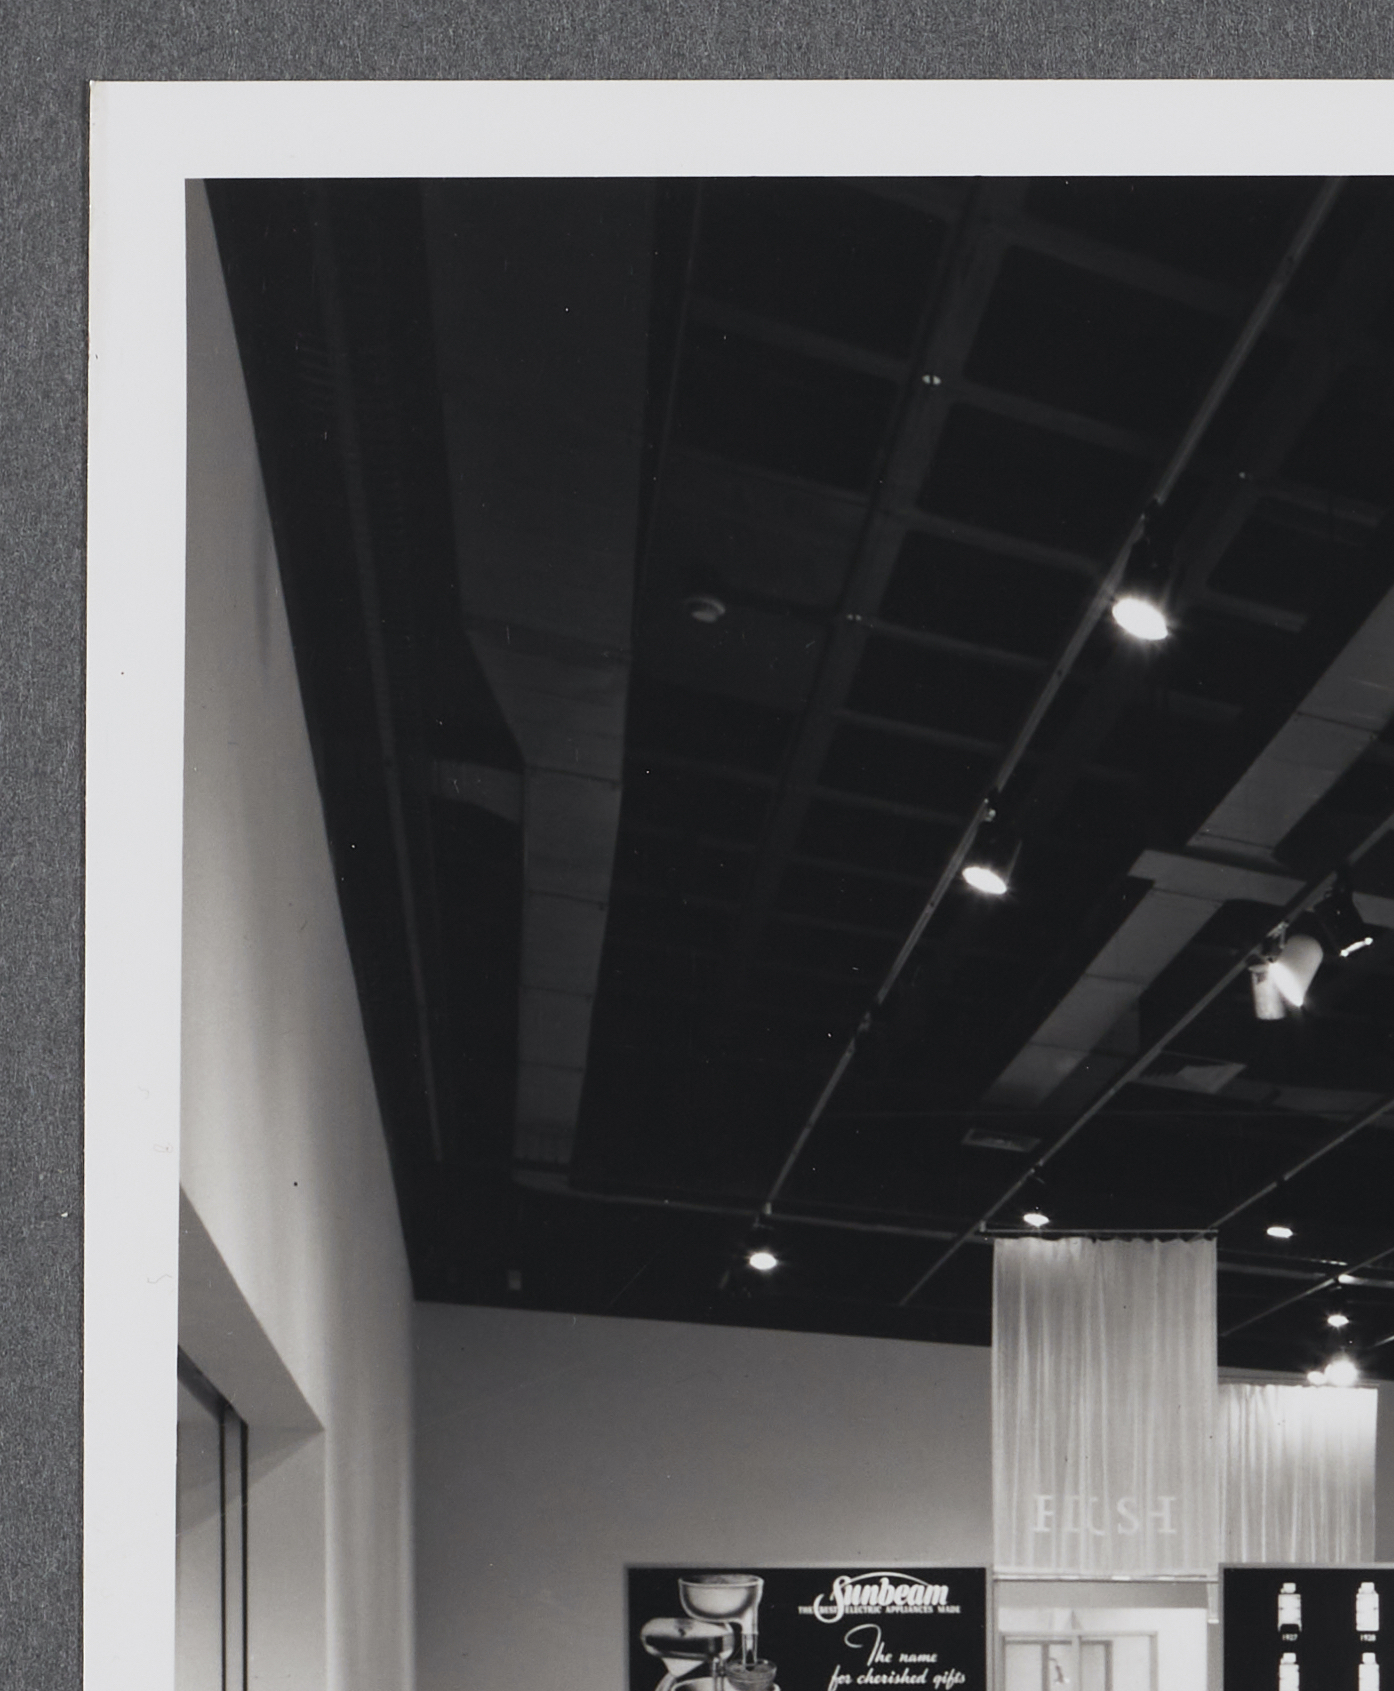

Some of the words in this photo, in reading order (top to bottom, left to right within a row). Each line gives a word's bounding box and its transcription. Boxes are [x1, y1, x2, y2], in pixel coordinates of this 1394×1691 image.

[813, 1572, 948, 1623] Sunbeam
[885, 1605, 934, 1614] APPLIANCES
[938, 1605, 961, 1614] MADE
[844, 1623, 893, 1667] The
[899, 1652, 938, 1663] name
[856, 1667, 929, 1685] cherished
[932, 1668, 966, 1690] gifts
